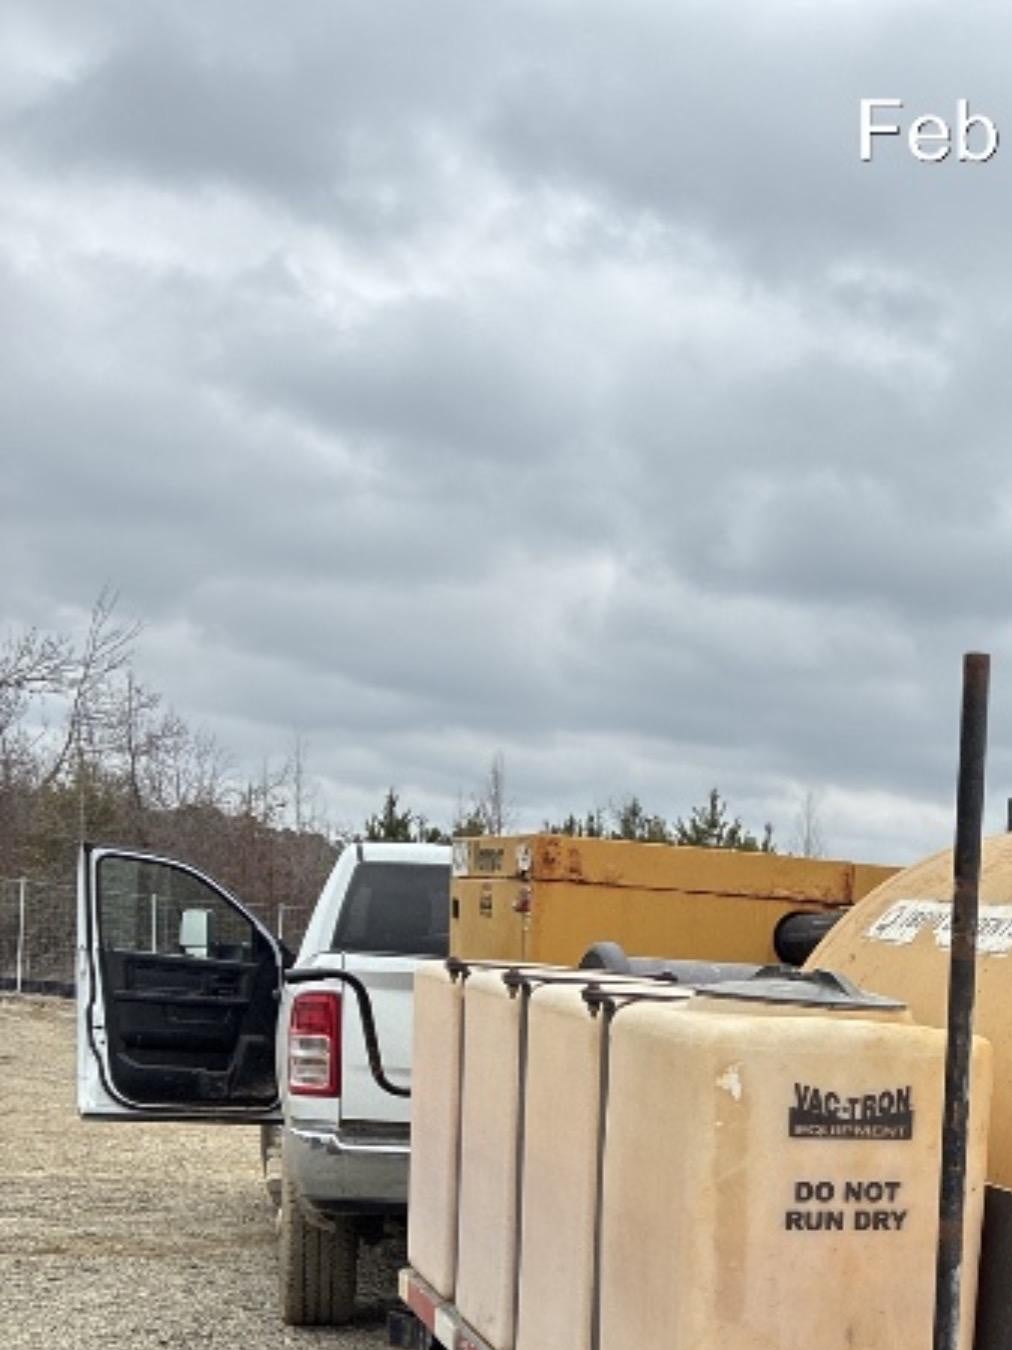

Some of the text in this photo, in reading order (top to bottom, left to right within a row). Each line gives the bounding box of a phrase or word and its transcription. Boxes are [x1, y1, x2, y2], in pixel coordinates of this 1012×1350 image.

[794, 1181, 901, 1203] DO NOT
[784, 1210, 907, 1231] RUN DRY
